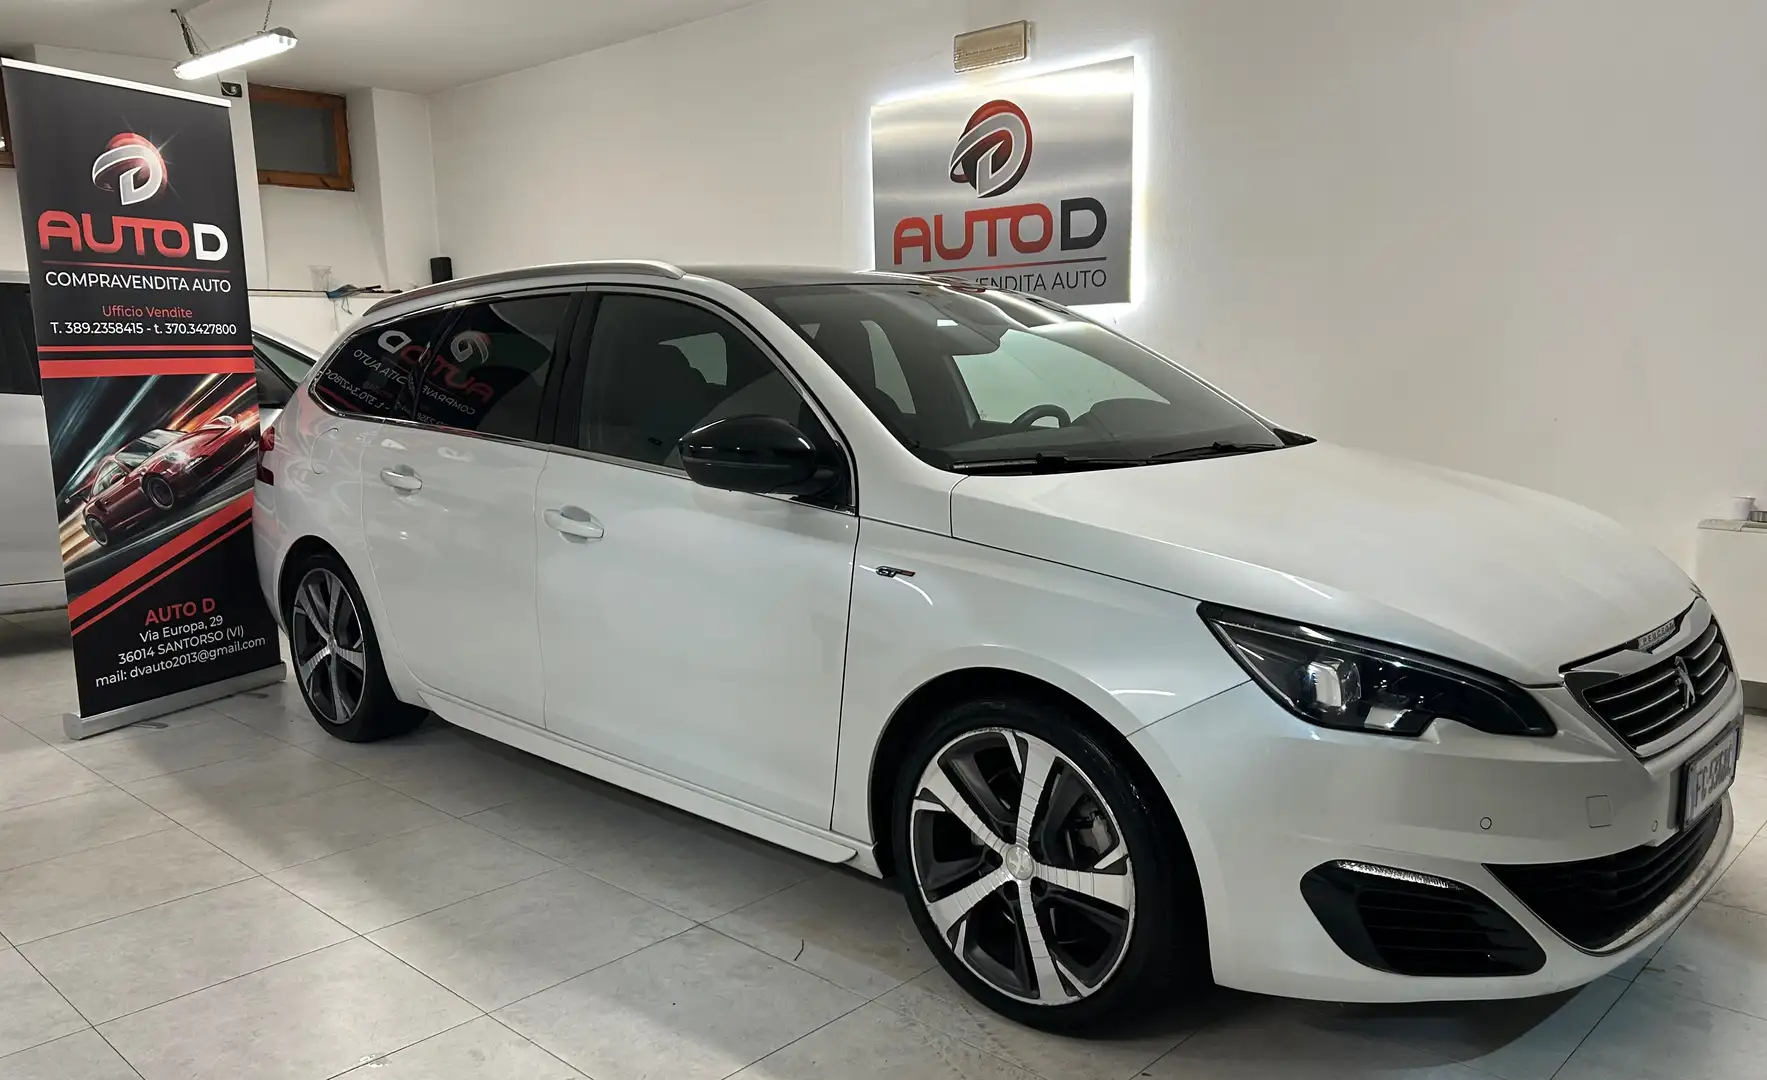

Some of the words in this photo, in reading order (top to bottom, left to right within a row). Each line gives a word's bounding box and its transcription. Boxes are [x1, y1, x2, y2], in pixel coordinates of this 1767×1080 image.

[37, 210, 190, 258] AUTO
[193, 222, 228, 261] D
[893, 203, 1054, 265] AUTO
[1060, 197, 1107, 251] D
[45, 271, 190, 292] COMPRAVENDITA
[192, 278, 231, 293] AUTO
[1051, 269, 1107, 290] AUTO
[101, 304, 143, 318] Ufficio
[145, 306, 193, 319] Vendite
[50, 322, 62, 334] T.
[65, 322, 144, 334] 389.2358415
[153, 324, 162, 335] t.
[165, 323, 237, 335] 370.3427800
[145, 602, 197, 626] AUTO
[202, 597, 216, 613] D
[139, 629, 160, 643] Via
[162, 620, 208, 639] Europa,
[209, 615, 223, 628] 29
[118, 647, 155, 666] 36014
[157, 630, 224, 656] SANTORSO
[226, 625, 244, 640] (VI)
[95, 668, 128, 688] mail:
[130, 636, 266, 678] dvauto2013@gmail.com
